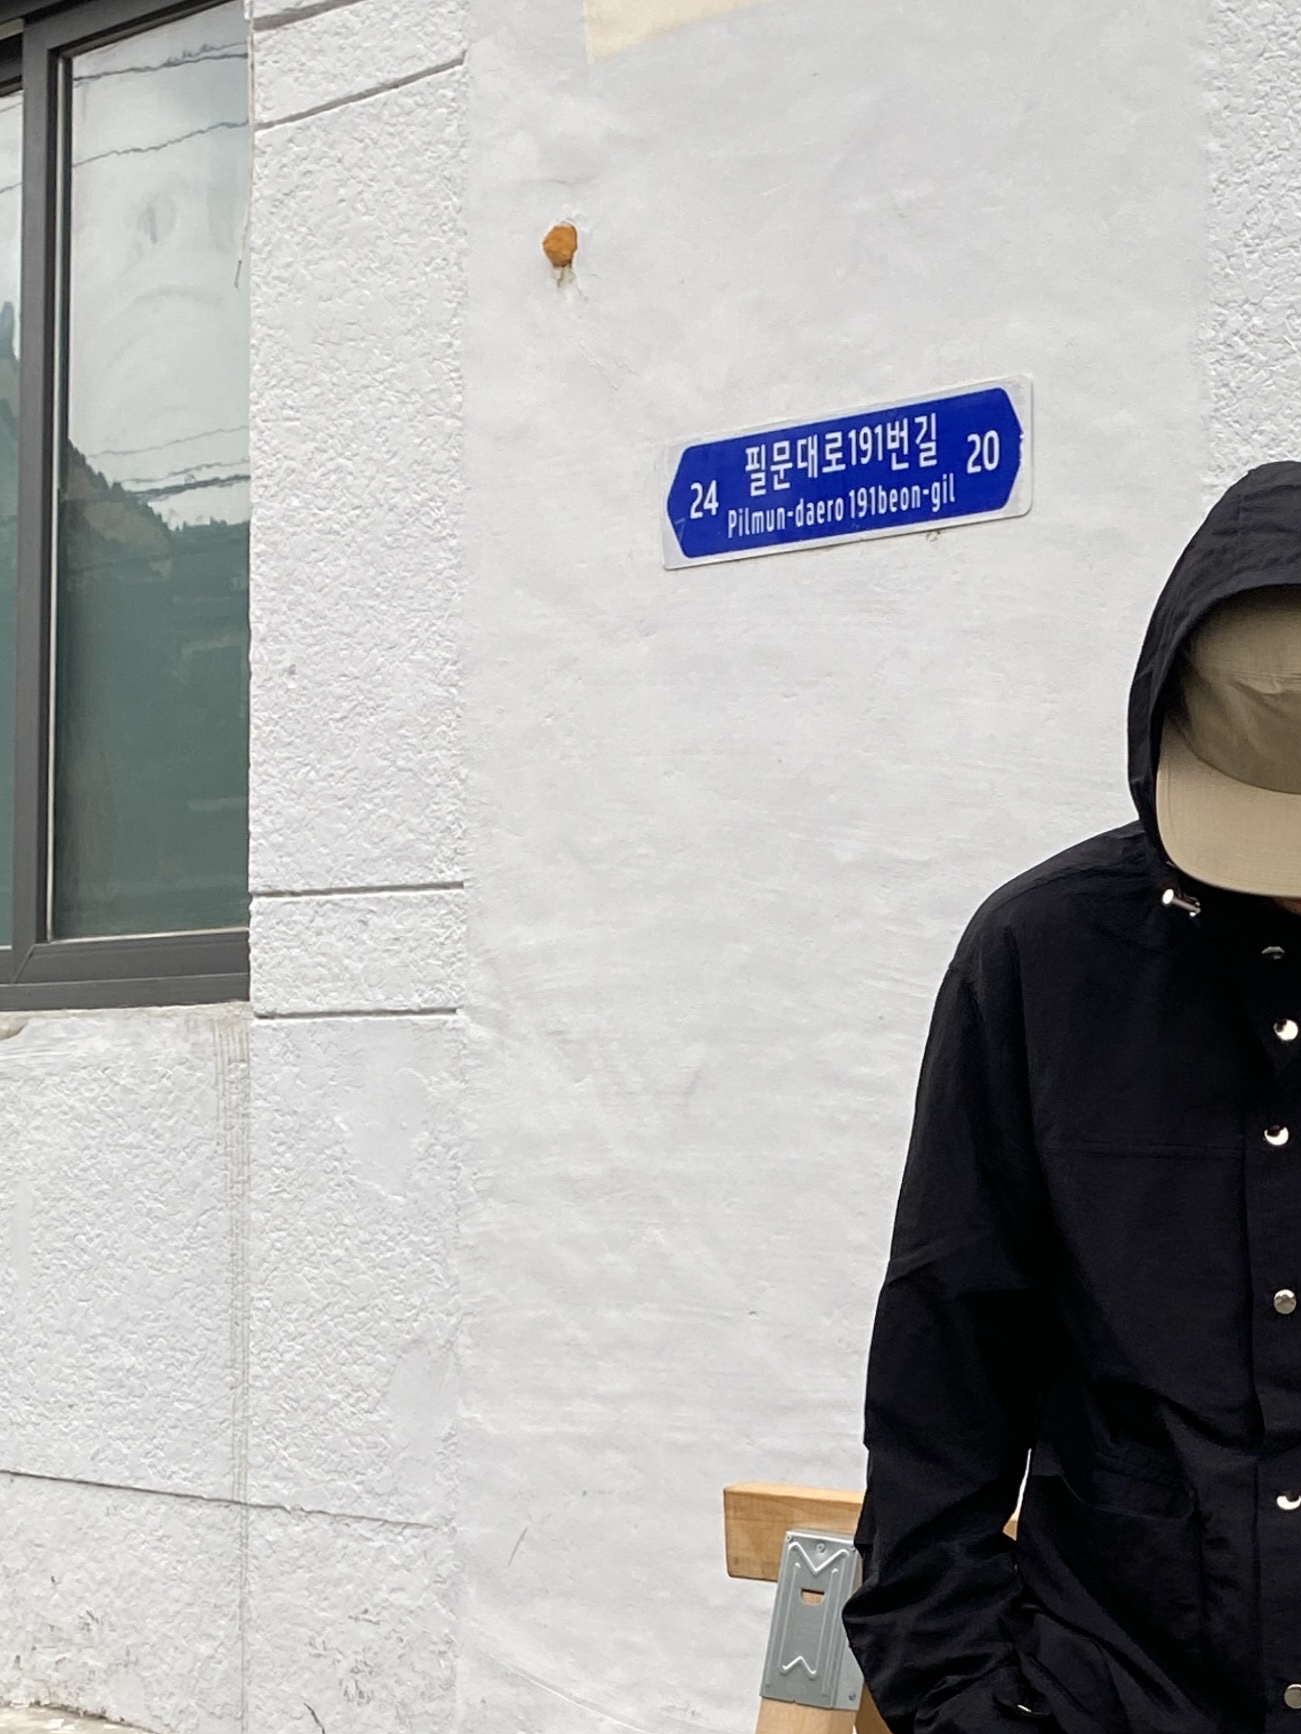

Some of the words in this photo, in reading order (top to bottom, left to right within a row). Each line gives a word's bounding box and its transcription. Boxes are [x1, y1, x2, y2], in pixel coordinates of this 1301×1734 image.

[745, 412, 938, 498] 필문대로191번길
[966, 430, 1000, 475] 20
[689, 479, 720, 519] 24
[727, 496, 844, 539] Pilmun-daero
[848, 472, 956, 520] 191beon-gil
